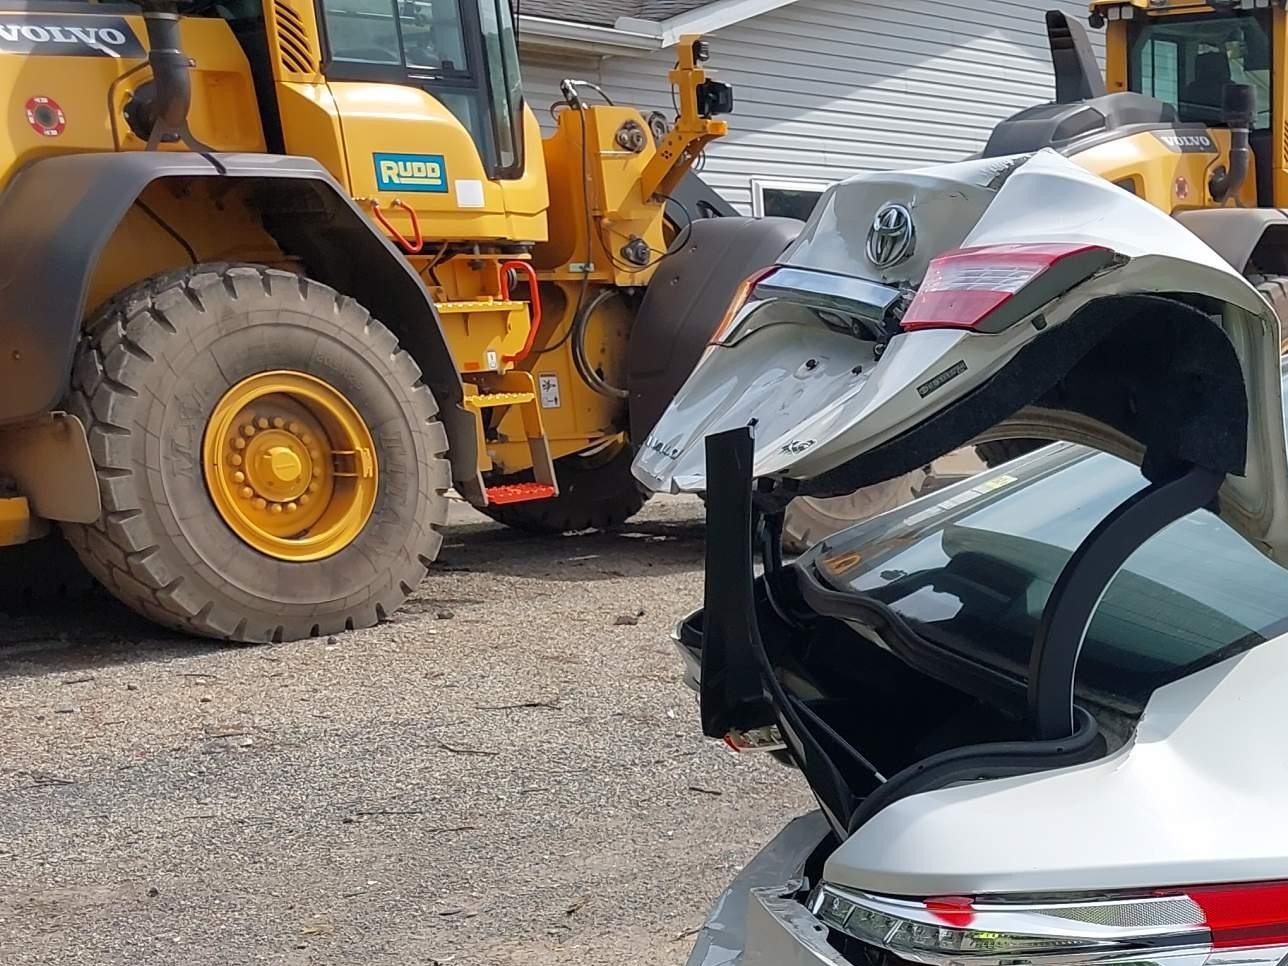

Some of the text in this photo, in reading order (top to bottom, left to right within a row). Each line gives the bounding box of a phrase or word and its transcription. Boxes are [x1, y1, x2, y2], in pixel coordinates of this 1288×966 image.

[0, 24, 126, 45] VOLVO
[1161, 135, 1210, 146] VOLVO
[380, 160, 441, 184] RUDD
